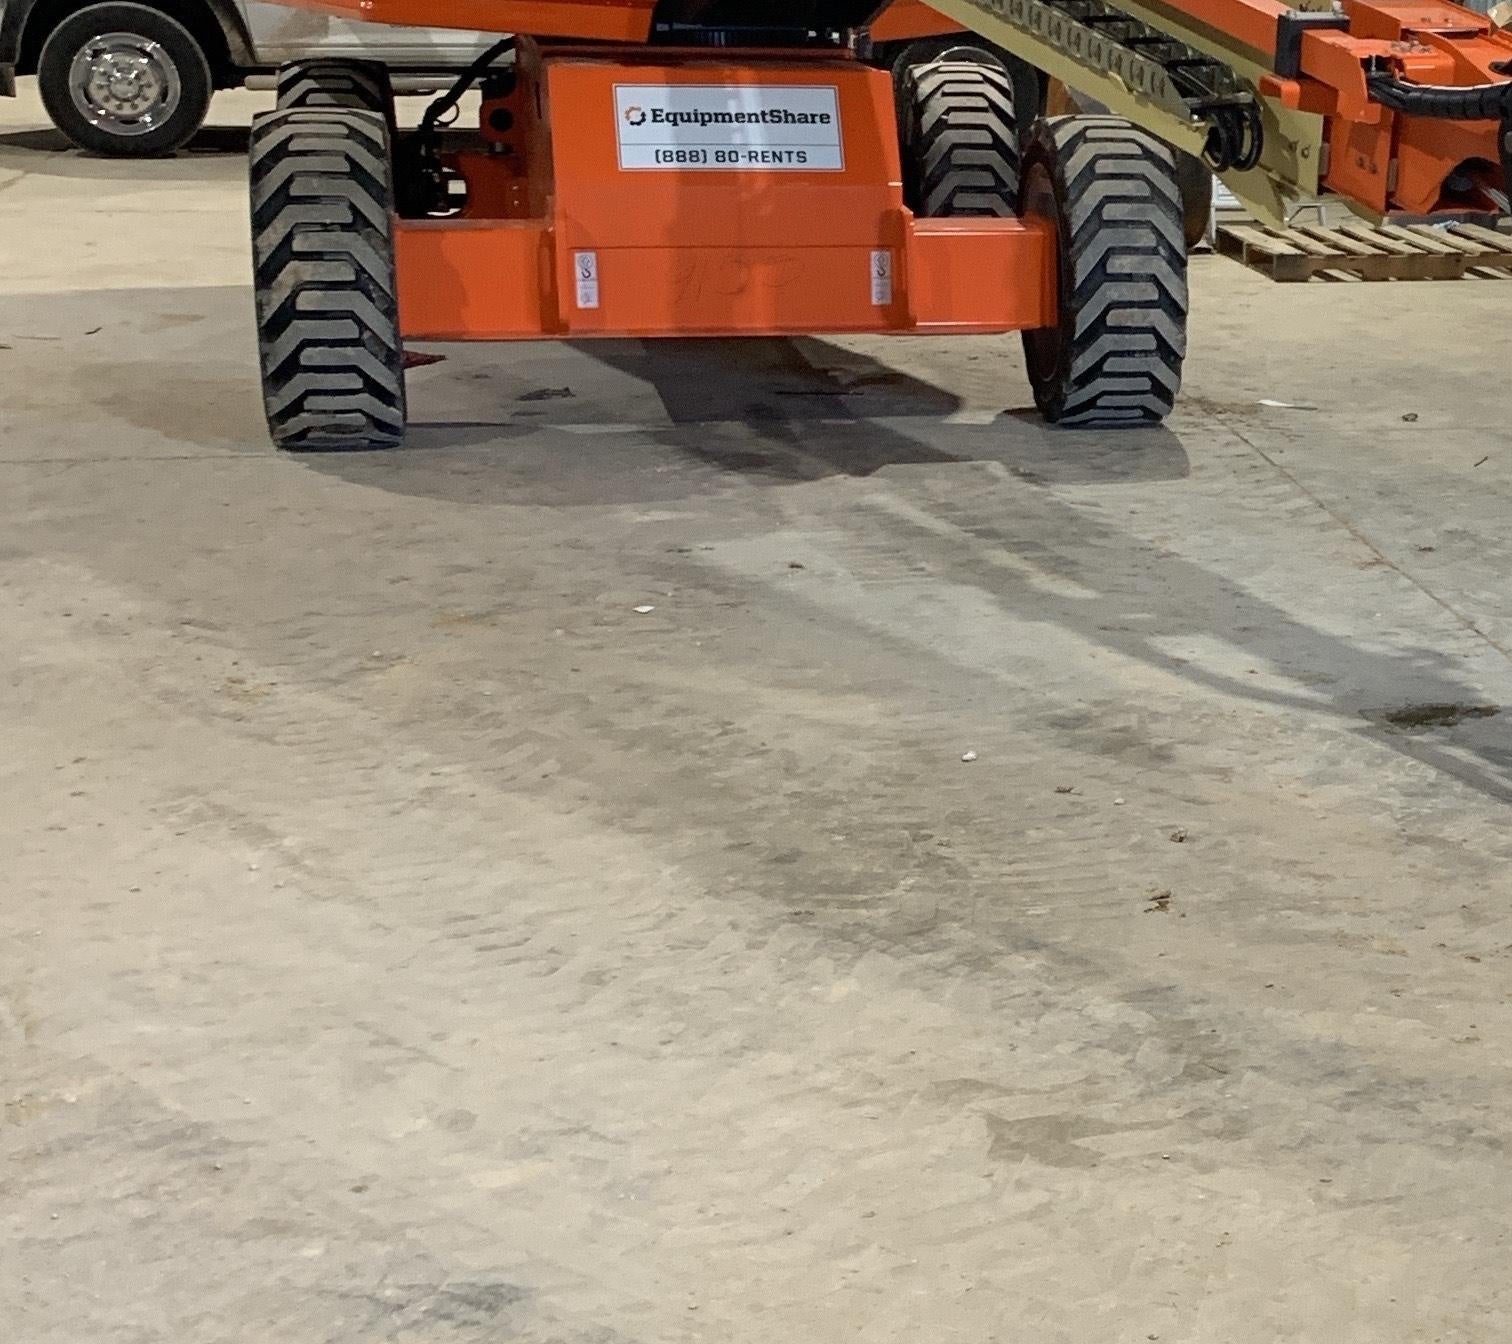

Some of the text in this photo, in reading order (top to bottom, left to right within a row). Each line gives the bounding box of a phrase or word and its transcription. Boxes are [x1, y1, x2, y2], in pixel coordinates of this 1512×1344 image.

[650, 107, 831, 127] EquipmentShare
[654, 148, 808, 165] (888) 80-RENTS
